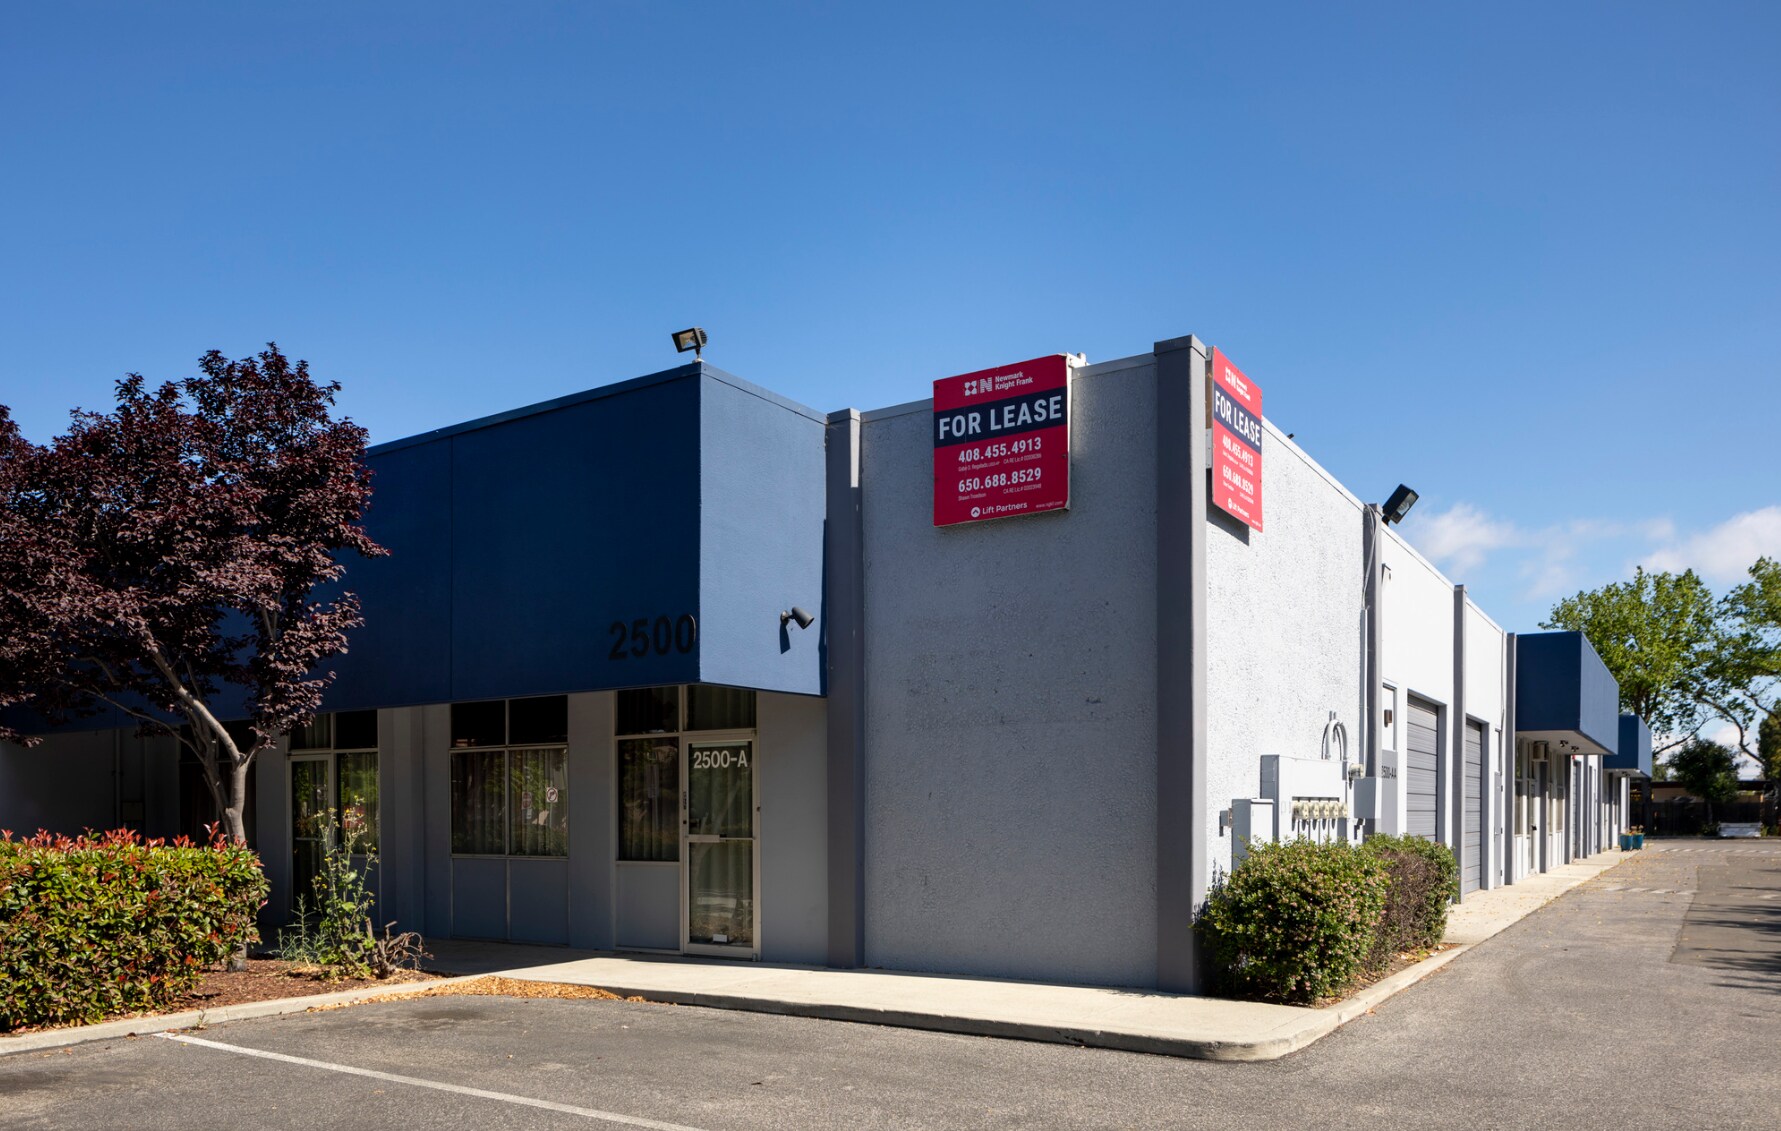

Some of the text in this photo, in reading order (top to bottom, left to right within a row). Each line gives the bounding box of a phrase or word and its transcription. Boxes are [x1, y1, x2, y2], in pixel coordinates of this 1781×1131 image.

[994, 371, 1024, 382] Newmark
[994, 376, 1034, 390] Knight Frank
[940, 396, 1062, 440] FOR LEASE
[1216, 390, 1232, 424] FOR
[1234, 407, 1260, 446] LEASE
[958, 436, 1042, 462] 408.455.4913
[958, 468, 1042, 492] 650.688.8529
[982, 502, 1028, 514] Lift Partners
[608, 613, 696, 660] 2500
[694, 750, 748, 769] 2500-A
